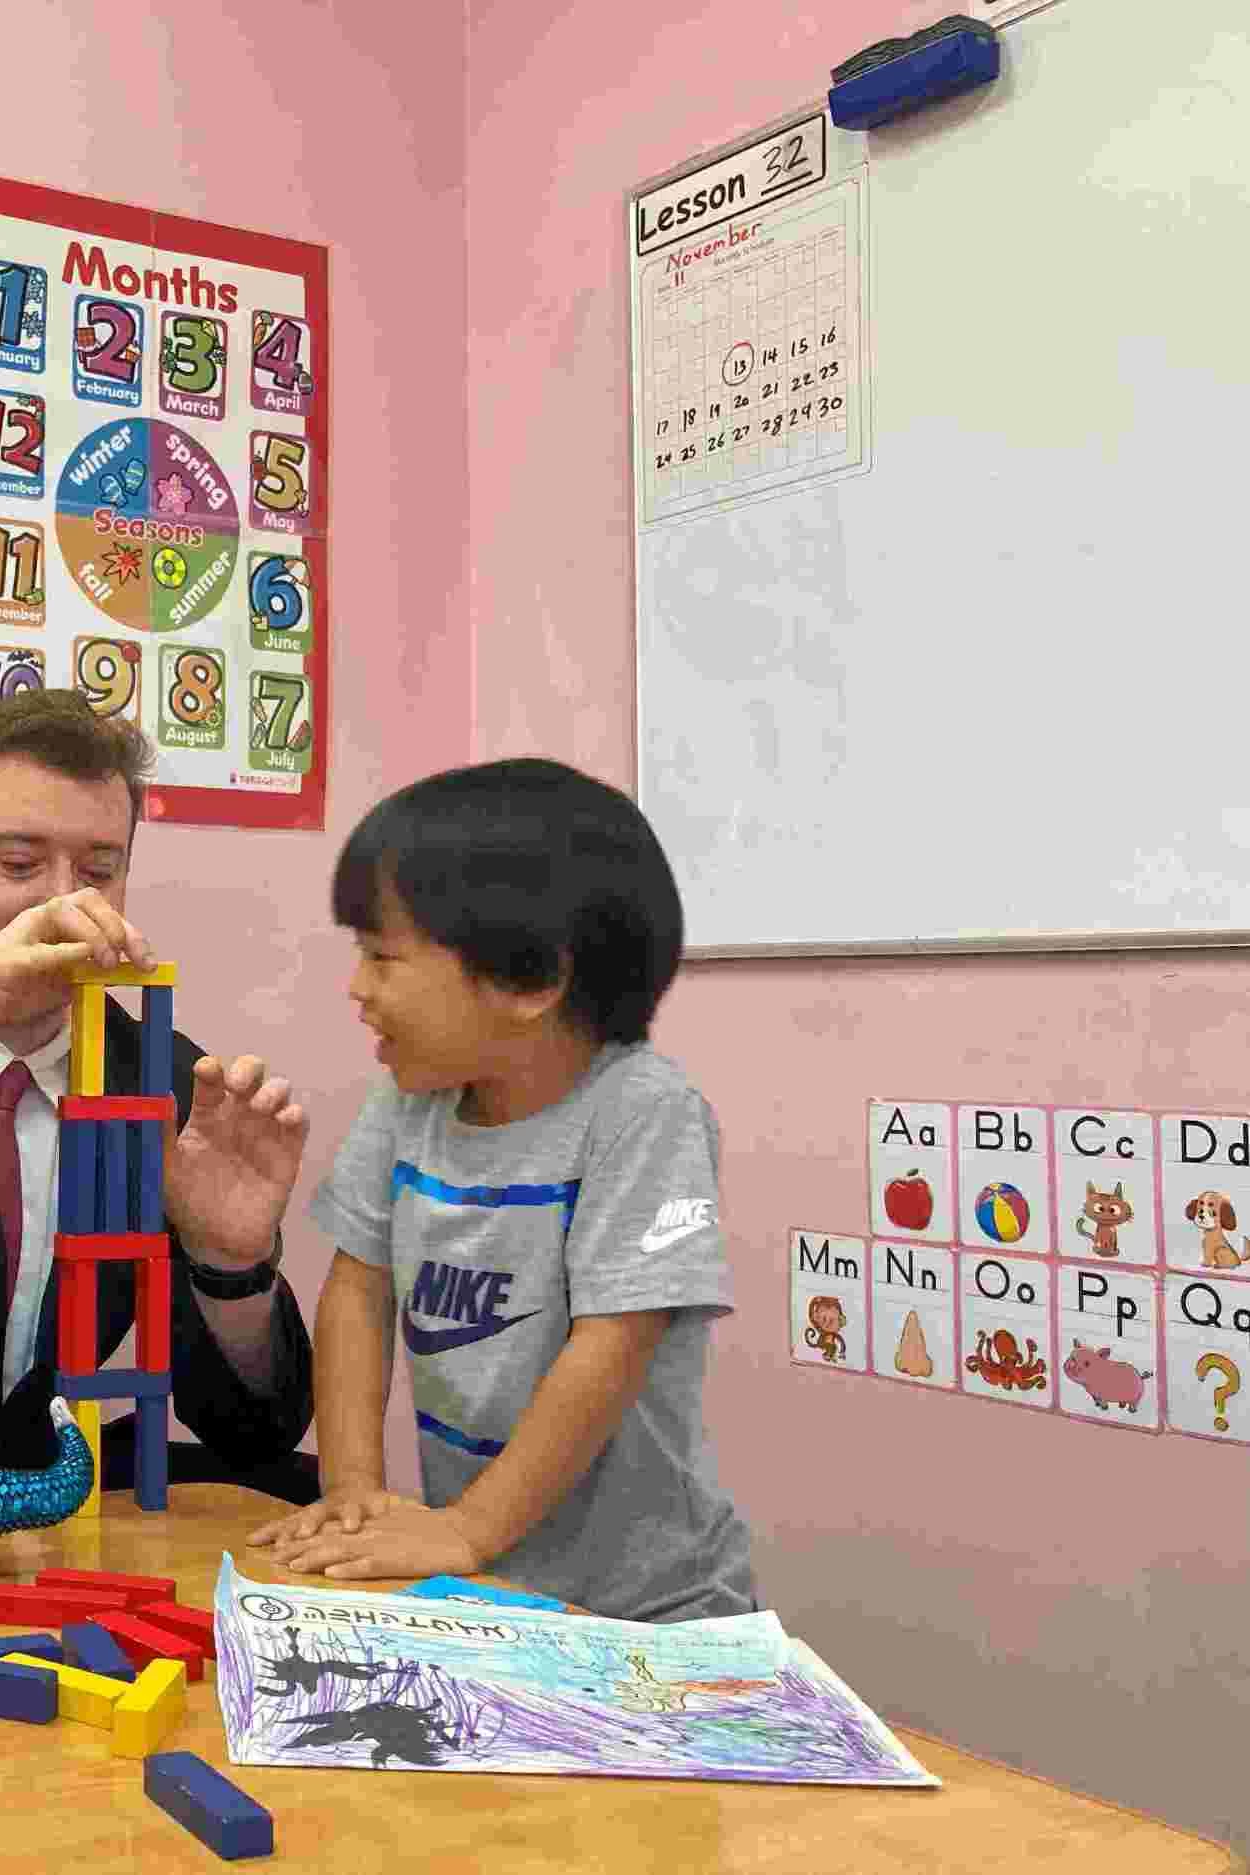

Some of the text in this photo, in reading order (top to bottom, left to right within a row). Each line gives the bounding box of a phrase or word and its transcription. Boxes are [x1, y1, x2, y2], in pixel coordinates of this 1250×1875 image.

[640, 135, 808, 242] Lesson 32
[62, 241, 239, 313] Months
[666, 223, 762, 272] November
[84, 301, 136, 384] 2
[170, 317, 218, 393] 3
[254, 319, 302, 390] 4
[733, 327, 836, 376] 13 14 15 16
[77, 380, 139, 403] February
[166, 394, 219, 417] March
[264, 391, 301, 410] April
[657, 420, 669, 435] 17
[683, 408, 696, 432] 18
[734, 395, 749, 409] 20
[762, 383, 778, 399] 21
[791, 373, 814, 392] 22
[819, 361, 839, 380] 23
[70, 426, 133, 486] winter
[656, 397, 843, 469] 24 25 26 27 28 29 30
[165, 433, 228, 511] spring
[255, 435, 305, 511] 5
[94, 508, 205, 546] Seasons
[263, 514, 295, 533] May
[78, 561, 114, 601] fall
[169, 552, 232, 624] summer
[251, 556, 303, 629] 6
[264, 634, 301, 651] June
[169, 649, 223, 725] 8
[260, 675, 304, 749] 7
[166, 725, 218, 745] August
[265, 751, 295, 770] July
[653, 1199, 714, 1227] NIKE
[412, 1260, 515, 1326] NIKE
